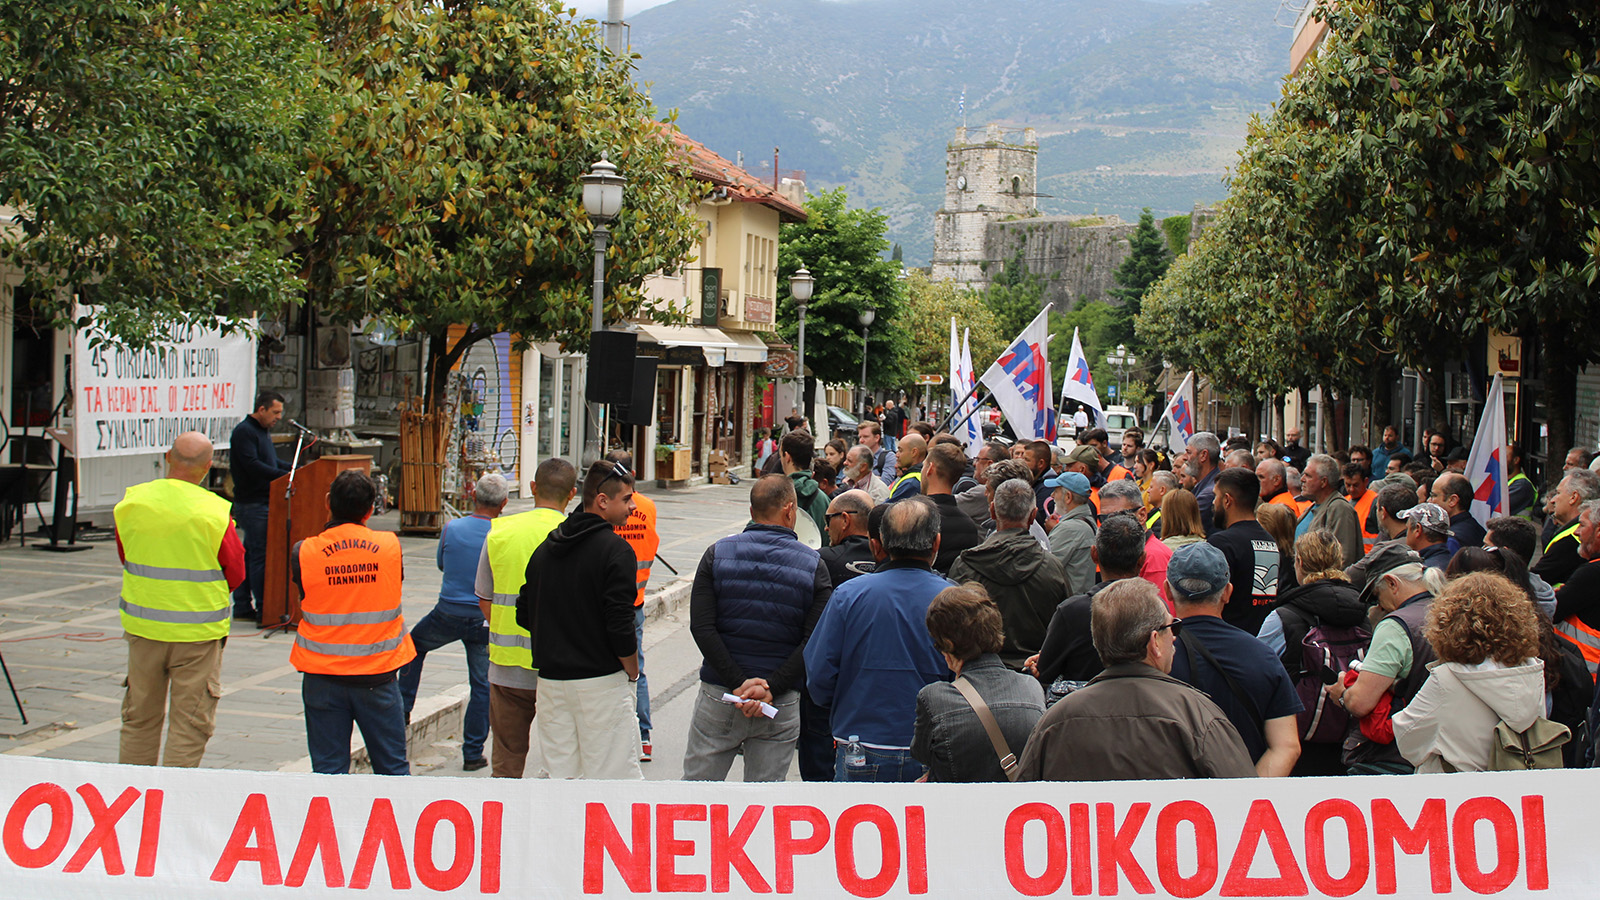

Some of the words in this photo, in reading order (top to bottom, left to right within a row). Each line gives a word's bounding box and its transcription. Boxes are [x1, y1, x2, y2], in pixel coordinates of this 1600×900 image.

[92, 345, 109, 378] 45
[183, 348, 219, 378] ΝΕΚΡΟΙ
[84, 386, 103, 413] ΤΑ
[107, 386, 137, 413] ΚΕΡΔΗ
[168, 385, 178, 412] ΟΙ
[211, 382, 236, 409] ΜΑΣ!
[96, 418, 156, 450] ΣΥΝΔΙΚΑΤΟ
[321, 538, 380, 557] ΣΥΝΔΙΚΑΤΟ
[325, 562, 379, 575] ΟΙΚΟΔΟΜΩΝ
[328, 574, 377, 586] ΓΙΑΝΝΙΝΩΝ
[2, 782, 164, 876] ΟΧΙ
[209, 793, 503, 894] ΑΛΛΟΙ
[582, 802, 928, 897] ΝΕΚΡΟΙ
[1004, 795, 1549, 898] ΟΙΚΟΔΟΜΟΙ
